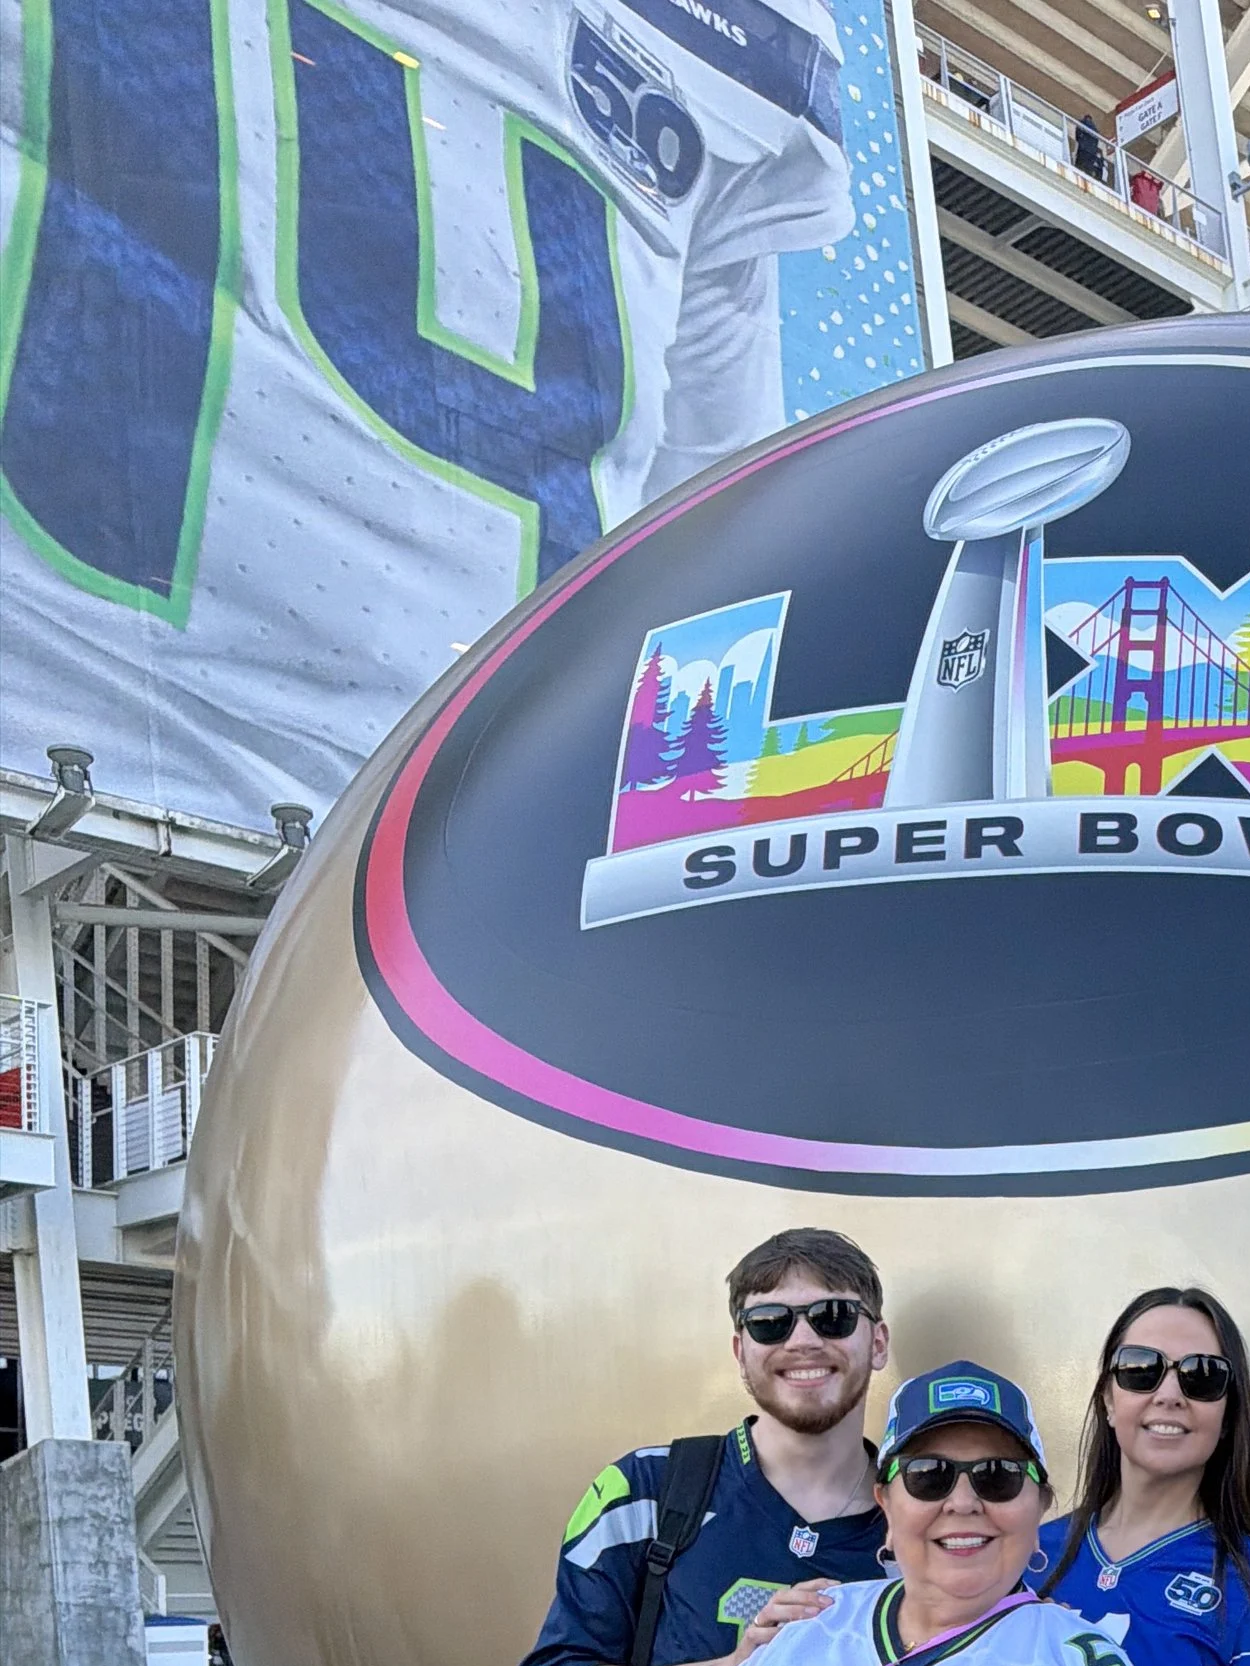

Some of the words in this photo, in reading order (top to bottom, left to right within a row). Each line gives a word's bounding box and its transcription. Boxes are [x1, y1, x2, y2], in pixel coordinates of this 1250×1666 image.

[941, 653, 977, 681] NFL
[683, 815, 1024, 890] SUPER
[793, 1539, 812, 1553] NFL
[1167, 1576, 1217, 1610] 50
